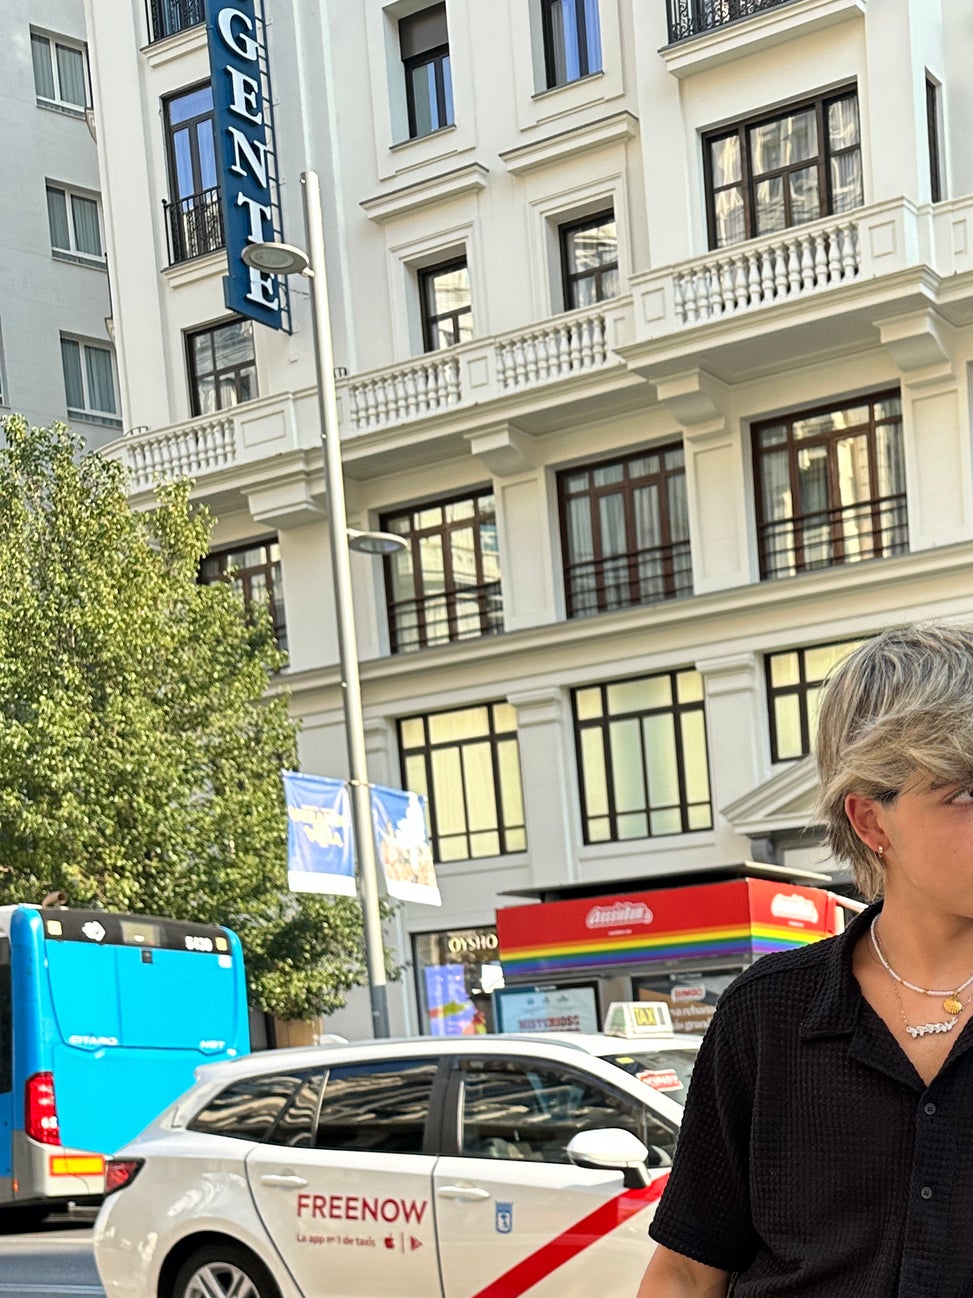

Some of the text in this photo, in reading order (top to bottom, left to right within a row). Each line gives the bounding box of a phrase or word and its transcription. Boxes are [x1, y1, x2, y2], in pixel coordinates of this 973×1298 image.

[297, 1194, 428, 1224] FREENOW
[309, 1235, 325, 1245] app
[343, 1236, 353, 1245] de
[355, 1236, 376, 1248] taxis
